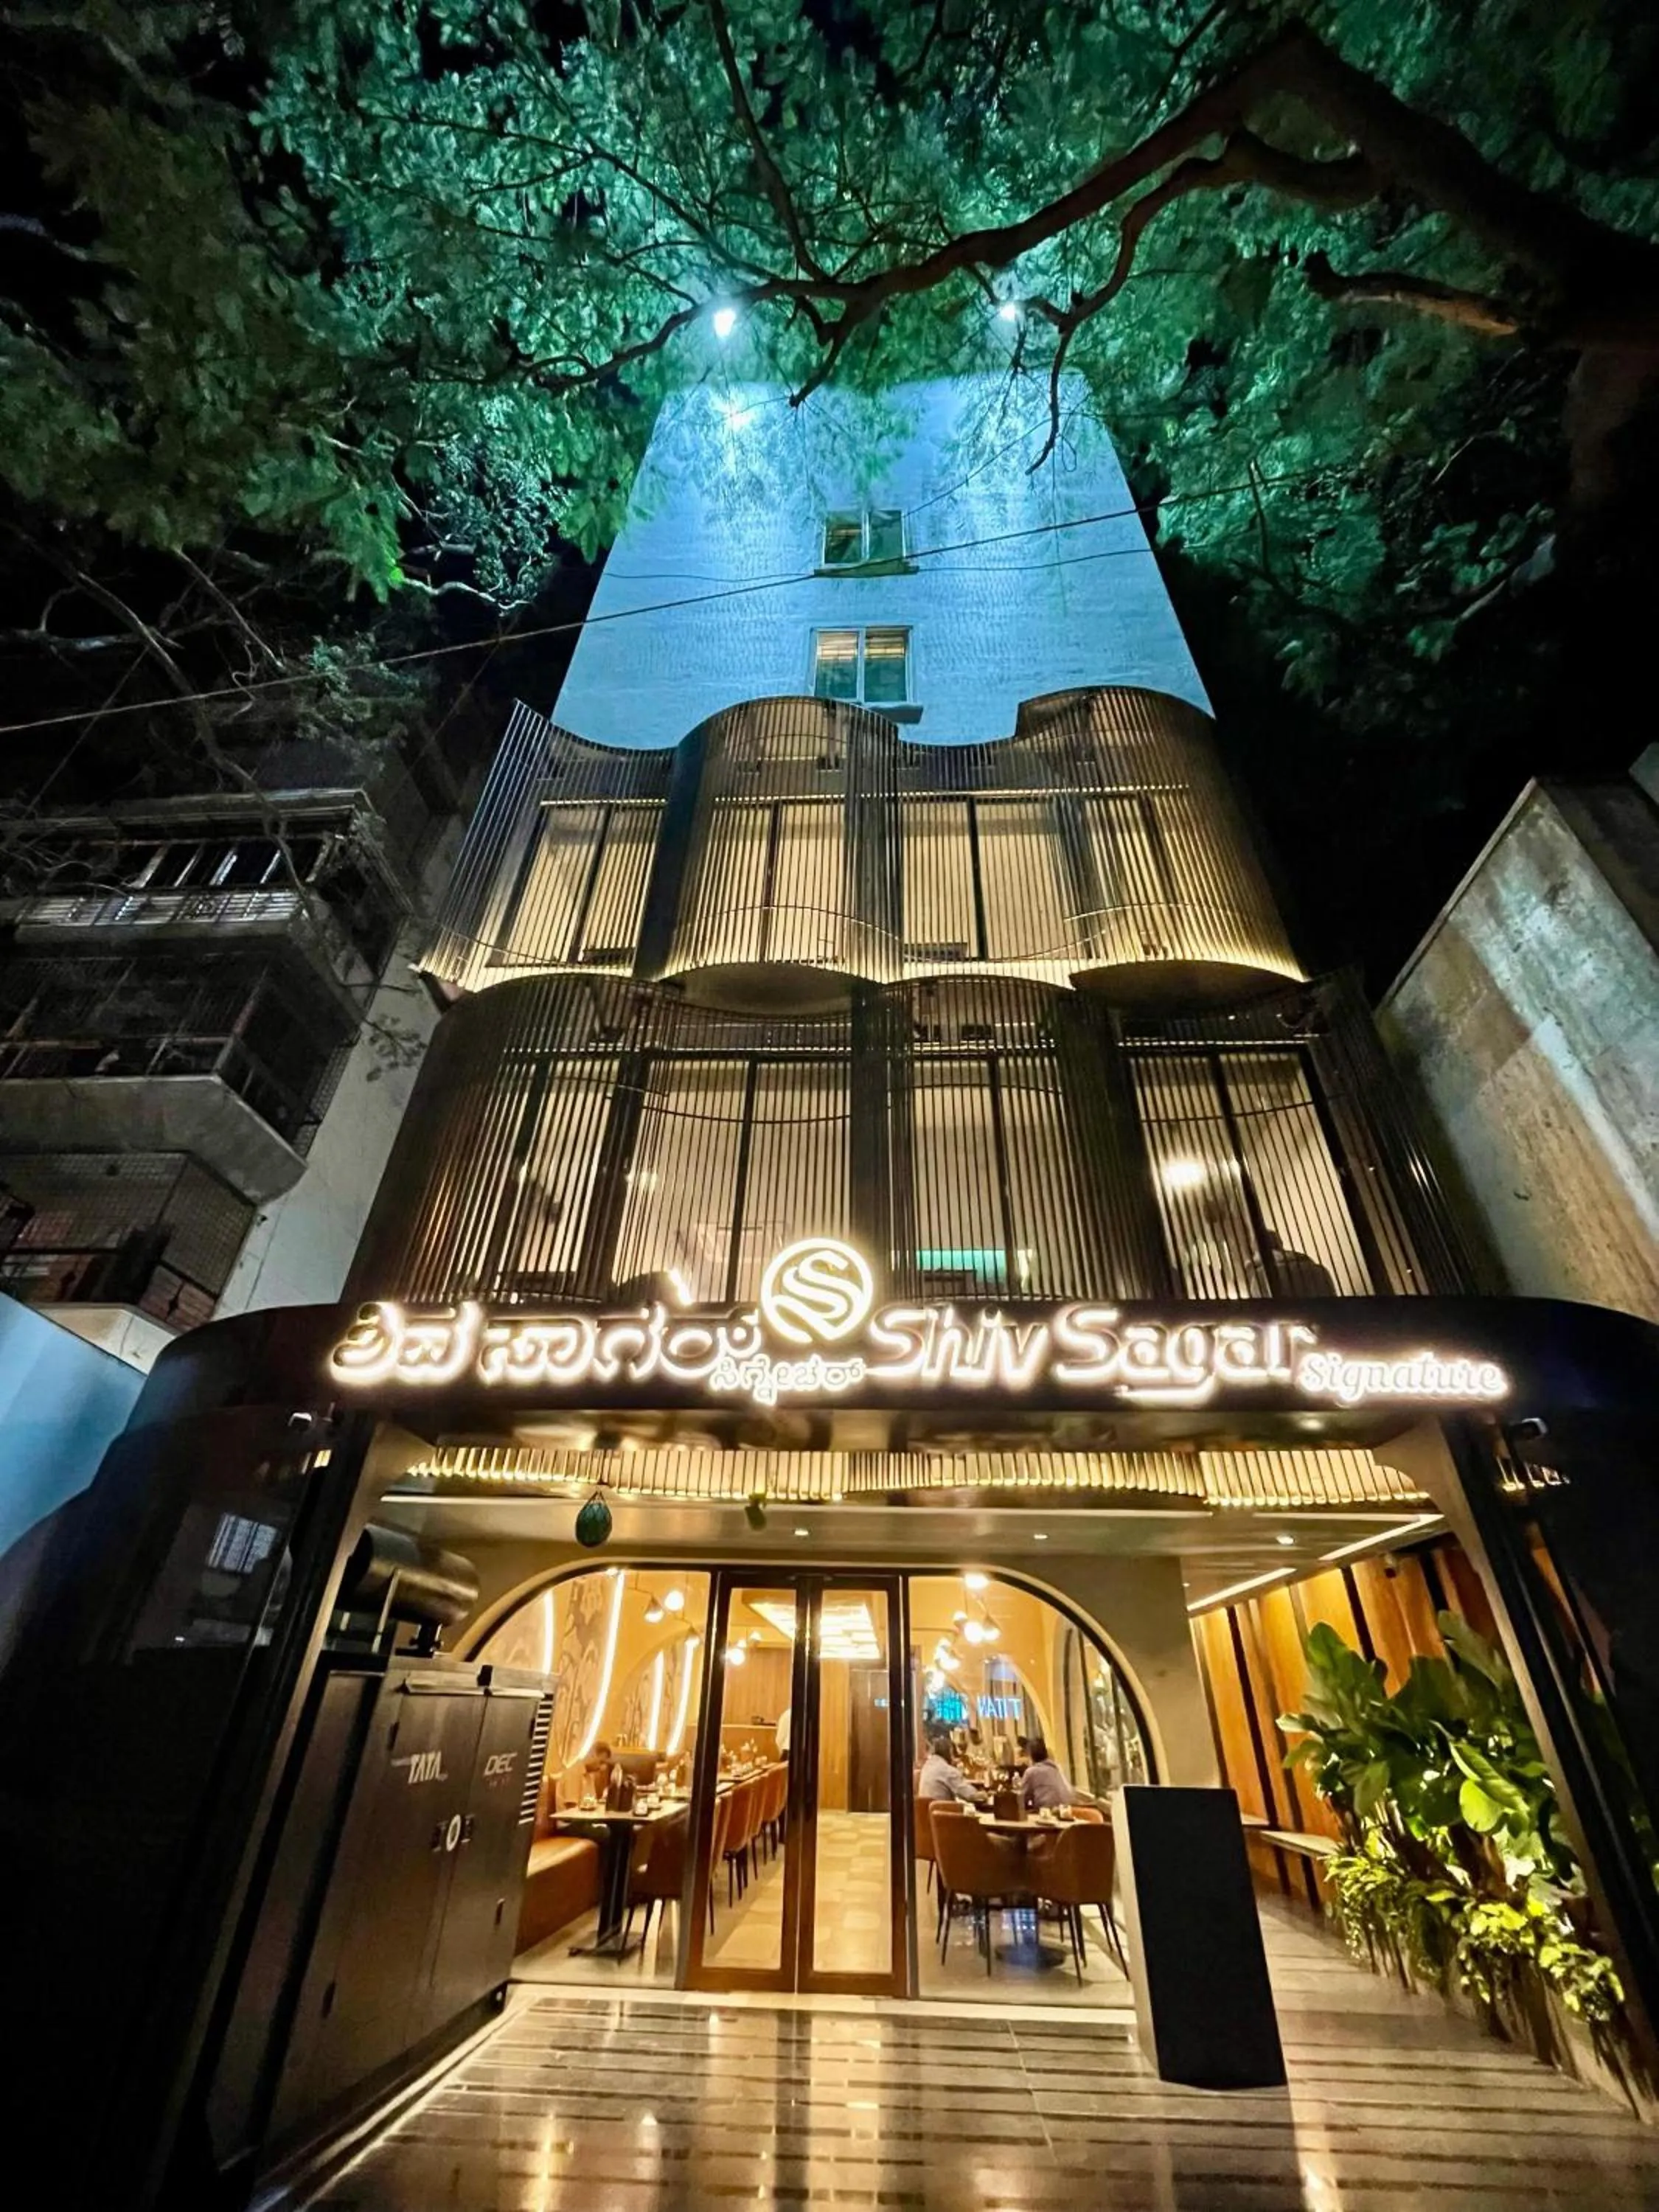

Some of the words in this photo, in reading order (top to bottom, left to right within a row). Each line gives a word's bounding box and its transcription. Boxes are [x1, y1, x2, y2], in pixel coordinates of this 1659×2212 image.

[330, 1301, 479, 1383] ಶಿವ
[478, 1301, 762, 1386] ಸಾಗರ್
[864, 1301, 1050, 1386] Shiv
[1051, 1302, 1318, 1407] Sagar
[1299, 1351, 1510, 1404] Signature
[407, 1750, 442, 1785] TATA
